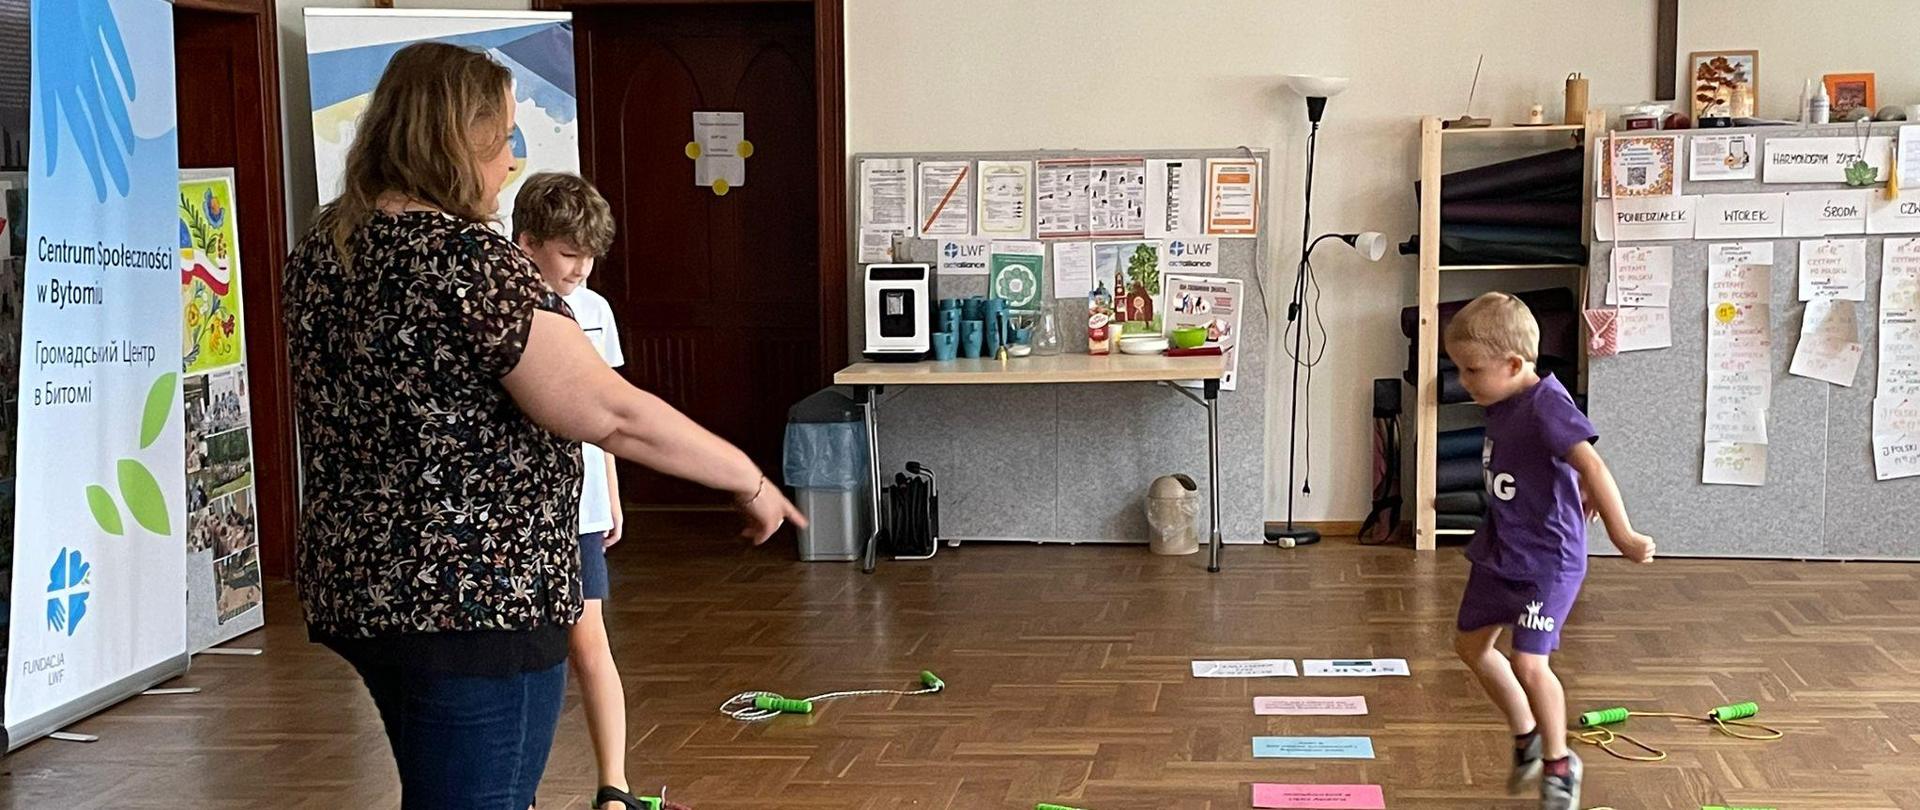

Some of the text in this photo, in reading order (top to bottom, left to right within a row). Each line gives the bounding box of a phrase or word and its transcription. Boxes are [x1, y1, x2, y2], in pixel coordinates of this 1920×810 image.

[1617, 210, 1687, 223] PONIEDZIAŁEK
[1724, 210, 1769, 221] WTOREK
[1823, 200, 1858, 217] ŚRODA
[38, 235, 173, 271] Centrum Społeczności
[961, 244, 985, 257] LWF
[1186, 243, 1212, 255] LWF
[37, 278, 103, 310] w Bytomiu
[35, 340, 156, 371] Громадський Центр
[34, 380, 92, 406] в Битомі
[1517, 613, 1555, 632] KING
[23, 652, 65, 678] FUNDACJA
[48, 669, 64, 686] LWF
